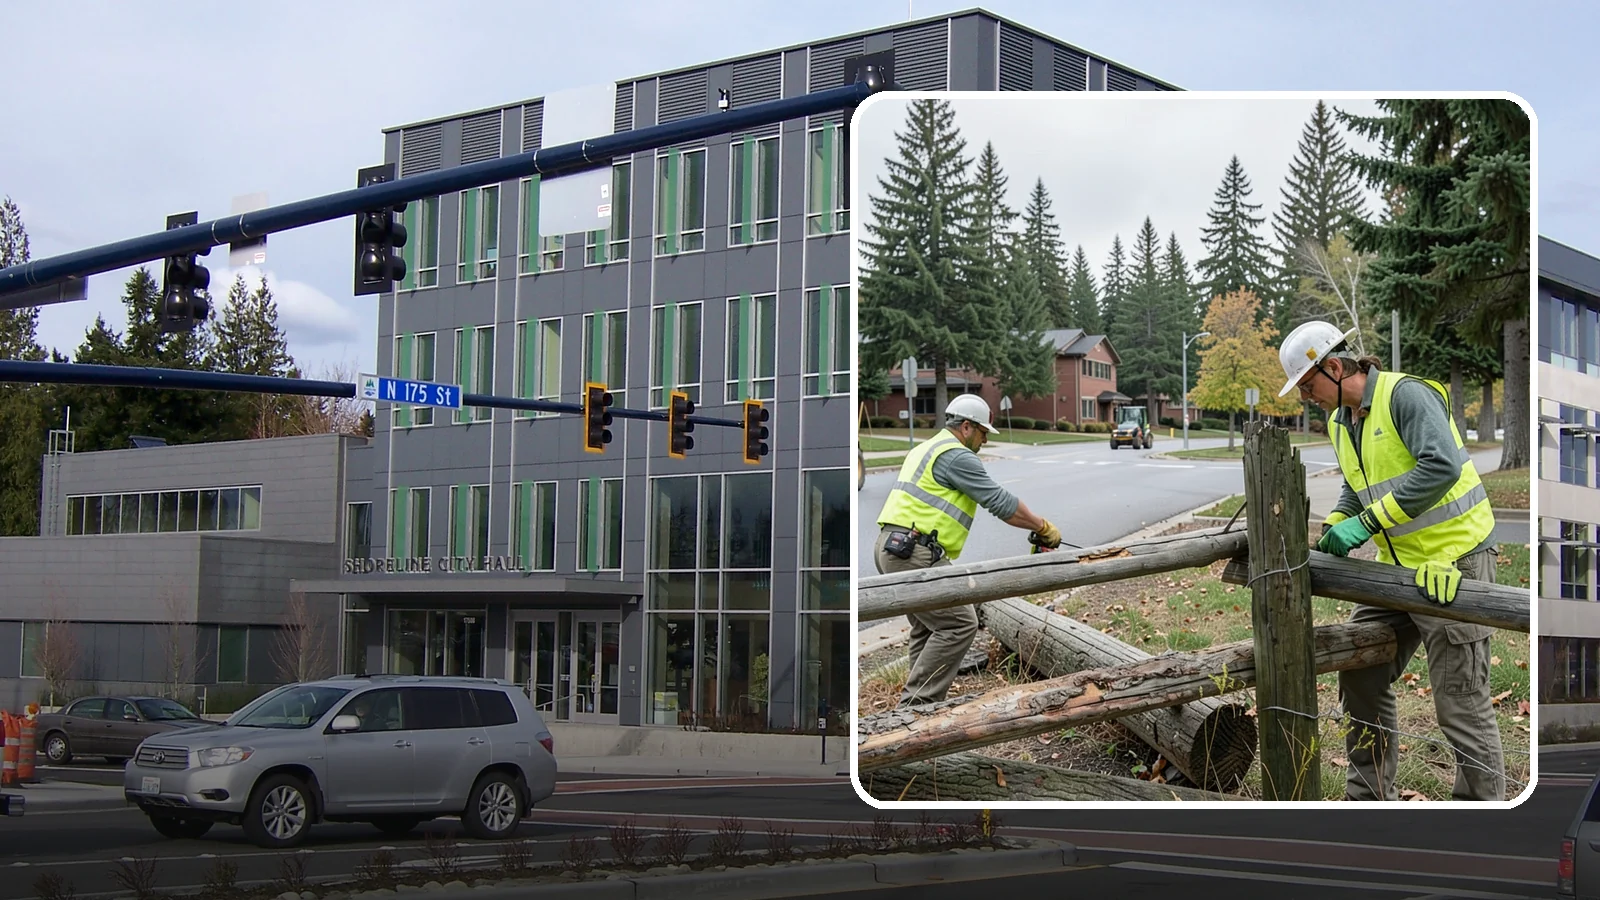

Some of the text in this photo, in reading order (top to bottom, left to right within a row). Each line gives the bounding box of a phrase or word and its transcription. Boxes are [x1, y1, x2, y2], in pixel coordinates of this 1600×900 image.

[387, 380, 451, 405] N 175 St
[344, 555, 526, 573] SHORELINE CITY HALL
